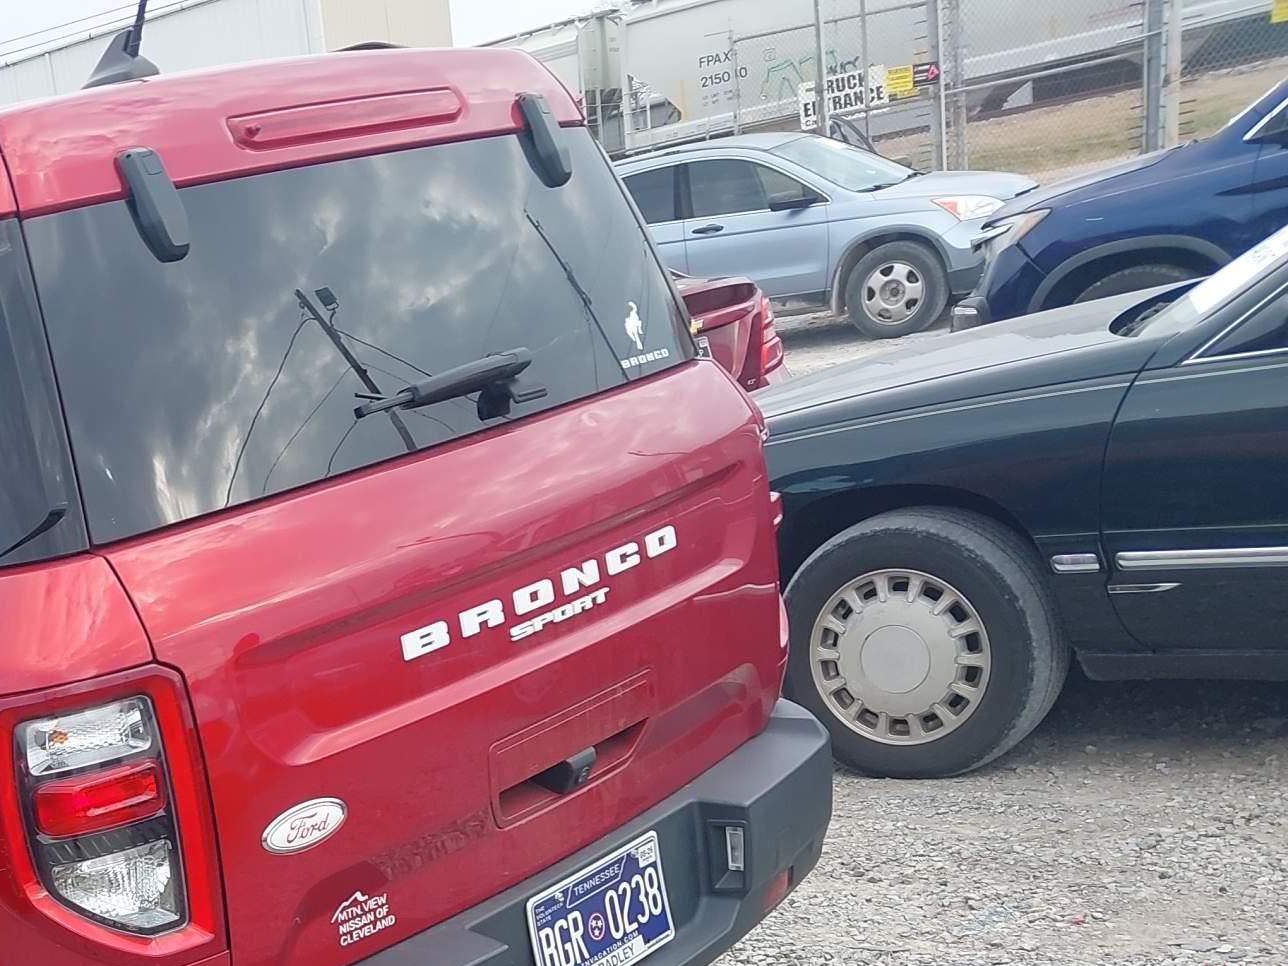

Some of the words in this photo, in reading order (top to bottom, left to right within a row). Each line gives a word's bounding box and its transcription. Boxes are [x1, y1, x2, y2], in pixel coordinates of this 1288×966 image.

[699, 48, 732, 68] FPAX
[701, 66, 748, 88] 21500
[620, 348, 670, 369] BRONCO
[400, 524, 678, 662] BRONCO
[509, 586, 611, 641] SPORT
[286, 812, 330, 844] Ford
[573, 862, 621, 897] TENNESSEE
[361, 893, 387, 914] VIEW
[604, 866, 663, 940] 0238
[339, 913, 375, 935] NISSAN
[376, 904, 390, 918] OF
[340, 914, 396, 946] CLEVELAND
